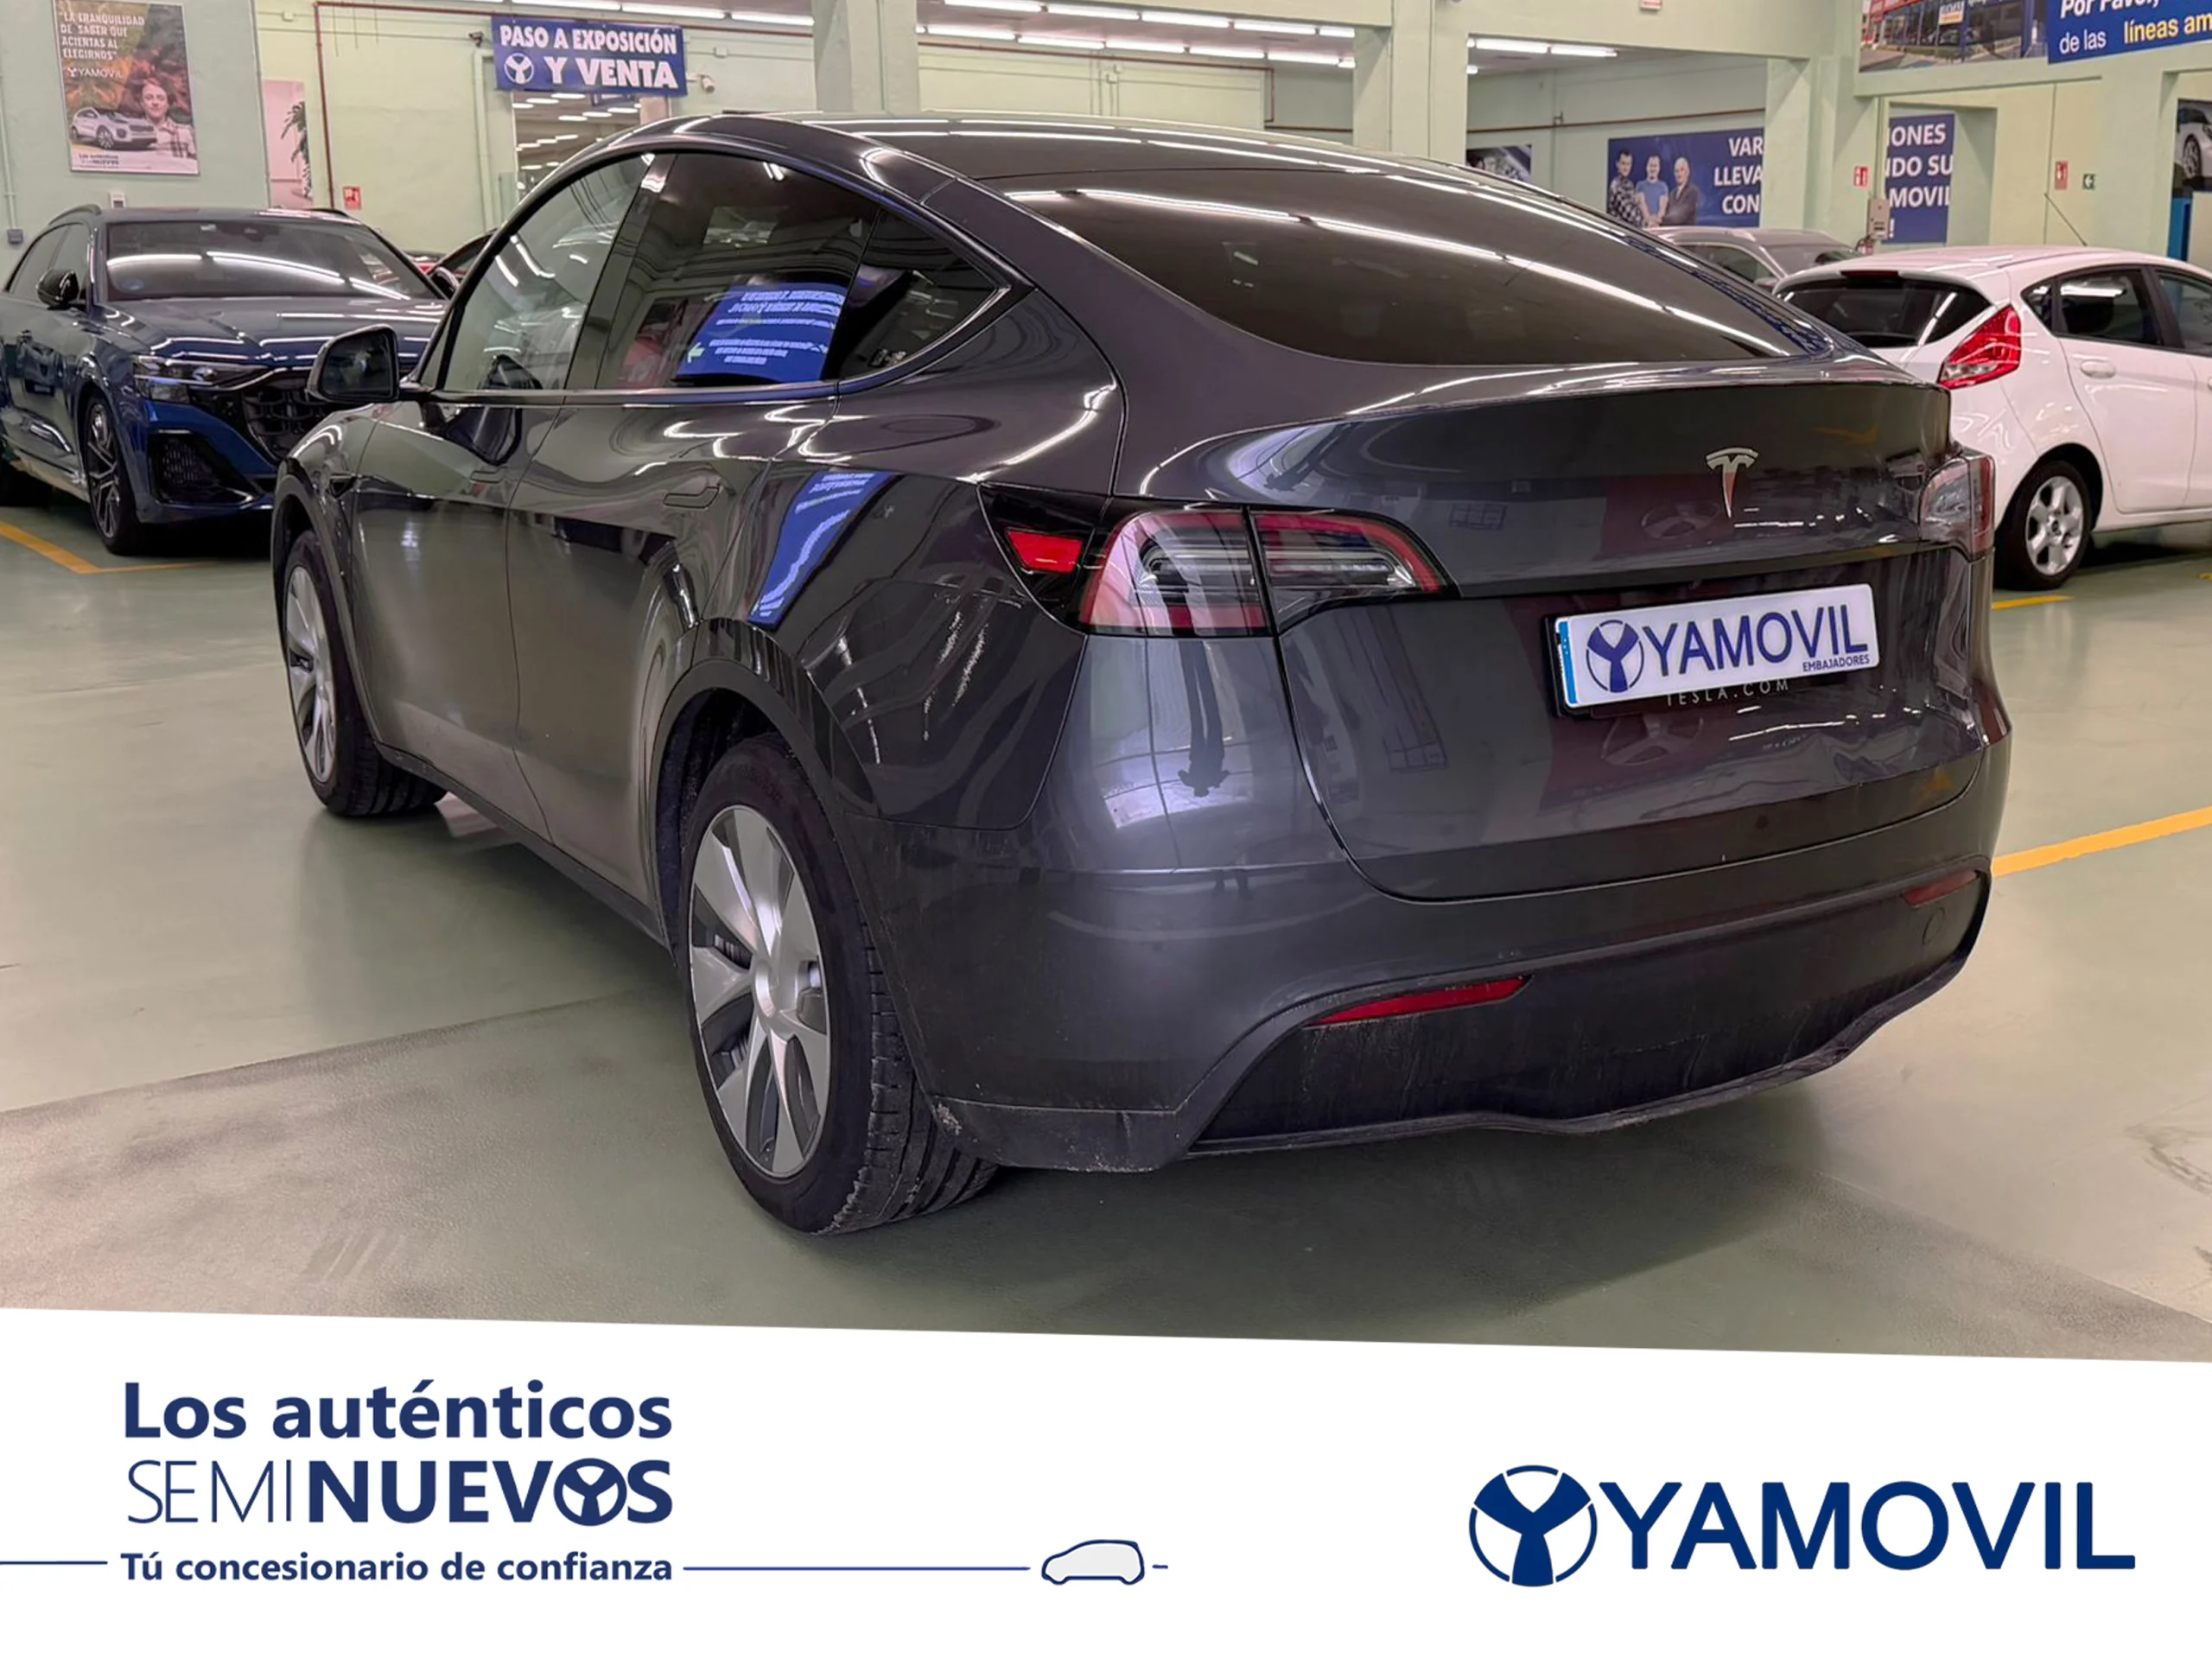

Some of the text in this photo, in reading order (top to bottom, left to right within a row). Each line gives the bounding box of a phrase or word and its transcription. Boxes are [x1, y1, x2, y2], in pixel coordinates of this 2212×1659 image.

[79, 12, 145, 26] TRANQUILIDAD
[2060, 0, 2158, 18] Por Fav,
[60, 23, 128, 37] DE SABER QUE
[499, 25, 677, 54] PASO A EXPOSICIÓN
[2059, 13, 2212, 54] de las líneas am
[61, 36, 118, 49] ACIERTAS AL
[543, 55, 678, 89] Y VENTA
[1714, 165, 1764, 187] LLEVA
[1927, 154, 1953, 176] SU
[1722, 194, 1760, 214] CON
[1643, 604, 1869, 677] YAMOVIL
[1802, 654, 1871, 673] EMBAJADORES
[1668, 678, 1789, 707] TESLA.COM
